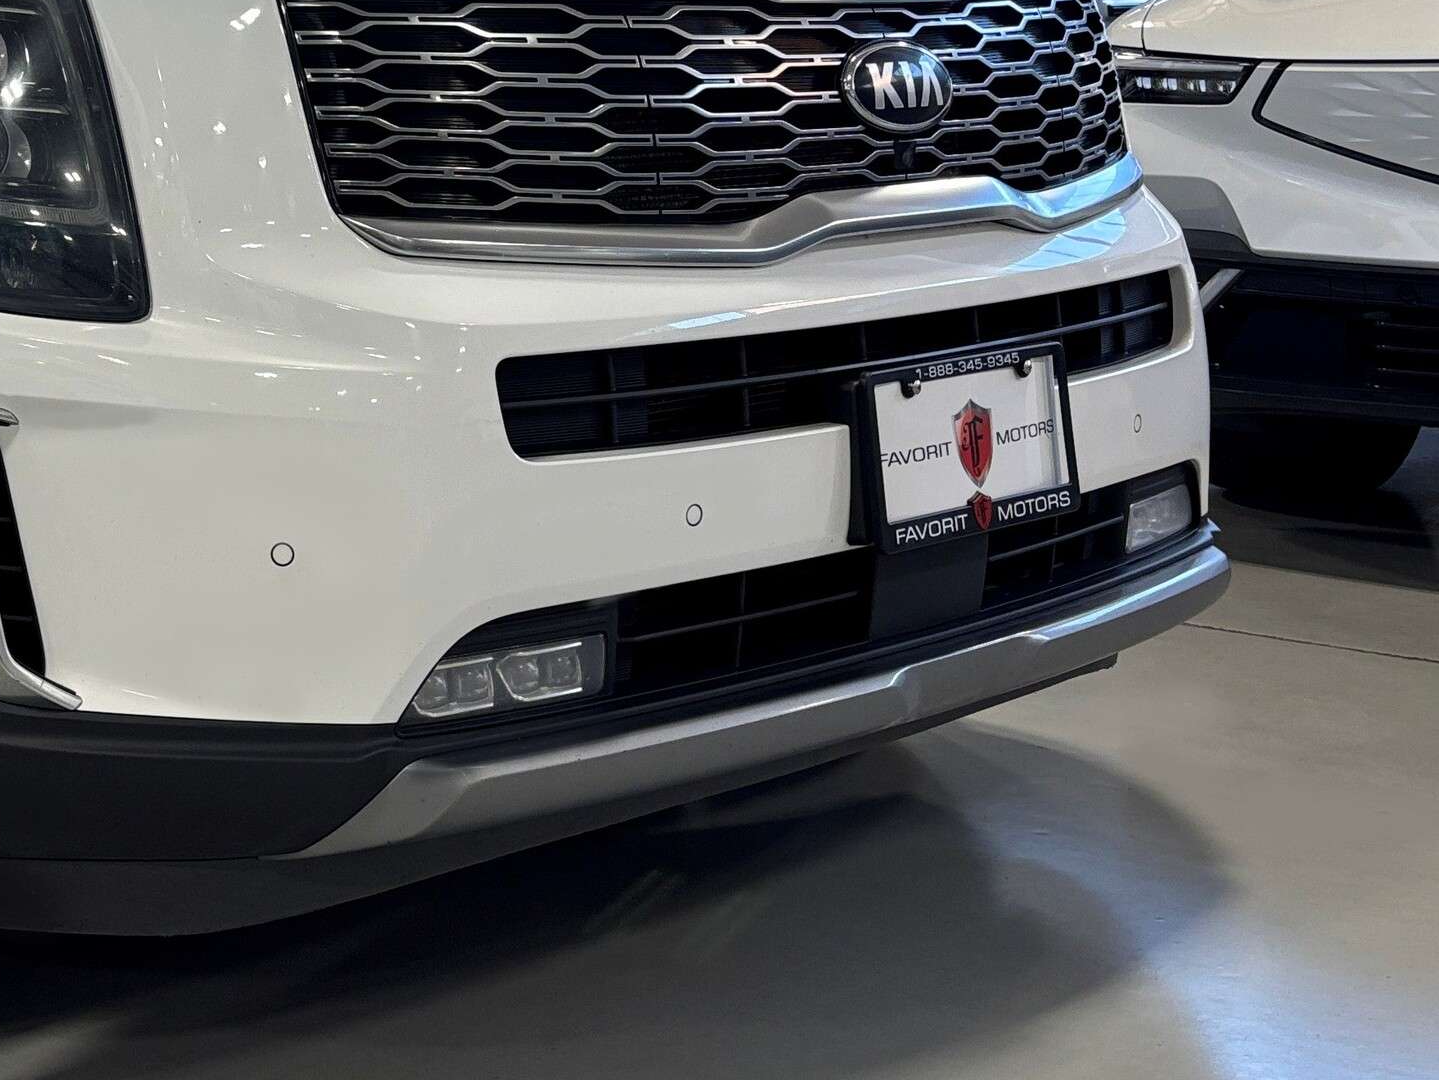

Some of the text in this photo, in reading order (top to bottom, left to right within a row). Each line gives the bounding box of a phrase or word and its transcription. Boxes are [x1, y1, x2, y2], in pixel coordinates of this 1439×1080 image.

[865, 60, 944, 110] KIA
[916, 352, 1020, 380] 1-888-345-9345
[880, 419, 1055, 467] FAVORIT MOTORS
[895, 491, 1071, 544] FAVORIT MOTORS
